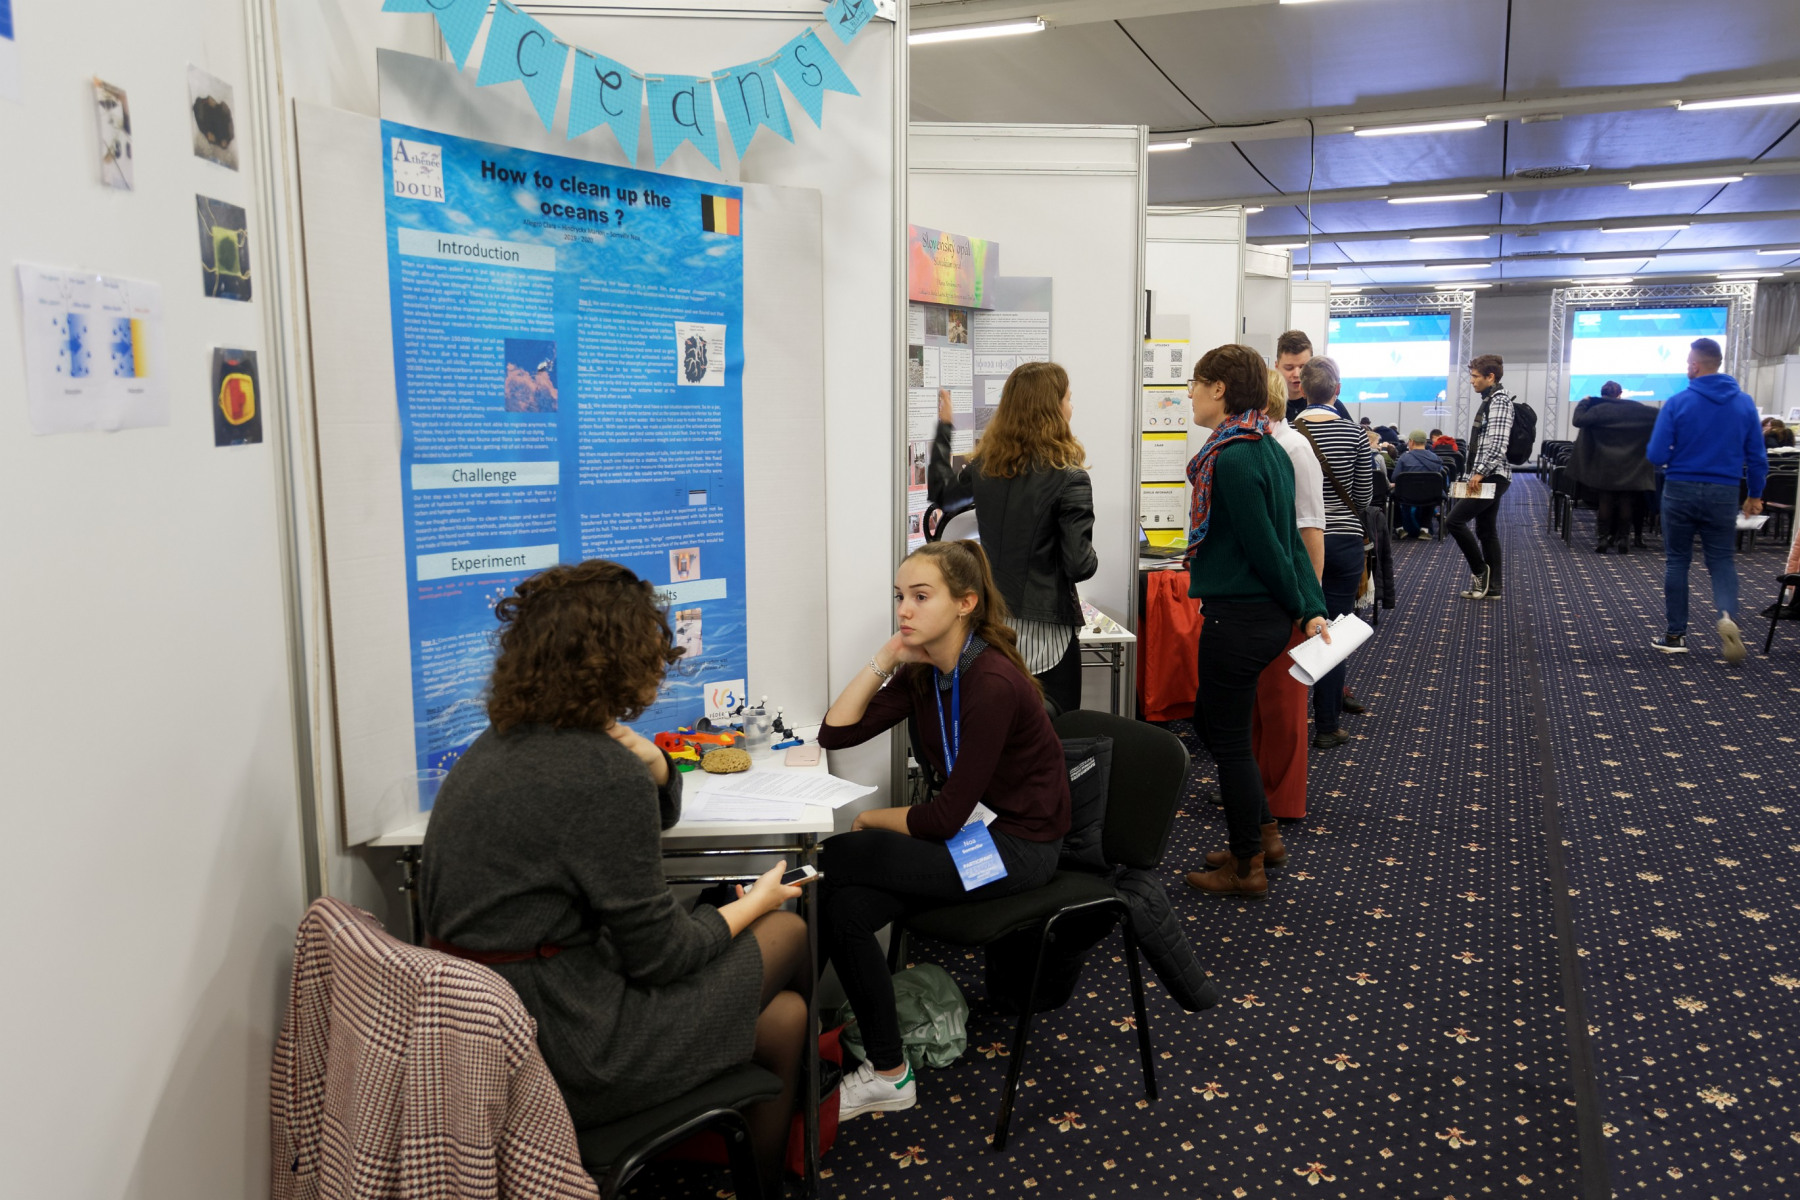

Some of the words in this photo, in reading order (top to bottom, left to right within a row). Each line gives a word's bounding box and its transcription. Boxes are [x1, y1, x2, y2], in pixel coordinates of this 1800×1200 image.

[395, 181, 443, 199] DOUR
[481, 160, 527, 184] How
[534, 171, 553, 188] to
[560, 176, 610, 199] clean
[617, 188, 638, 206] up
[644, 190, 671, 208] the
[540, 202, 609, 223] oceans
[615, 209, 624, 225] ?
[437, 239, 520, 262] Introduction
[452, 468, 517, 484] Challenge
[452, 553, 526, 572] Experiment
[963, 838, 976, 847] Noa
